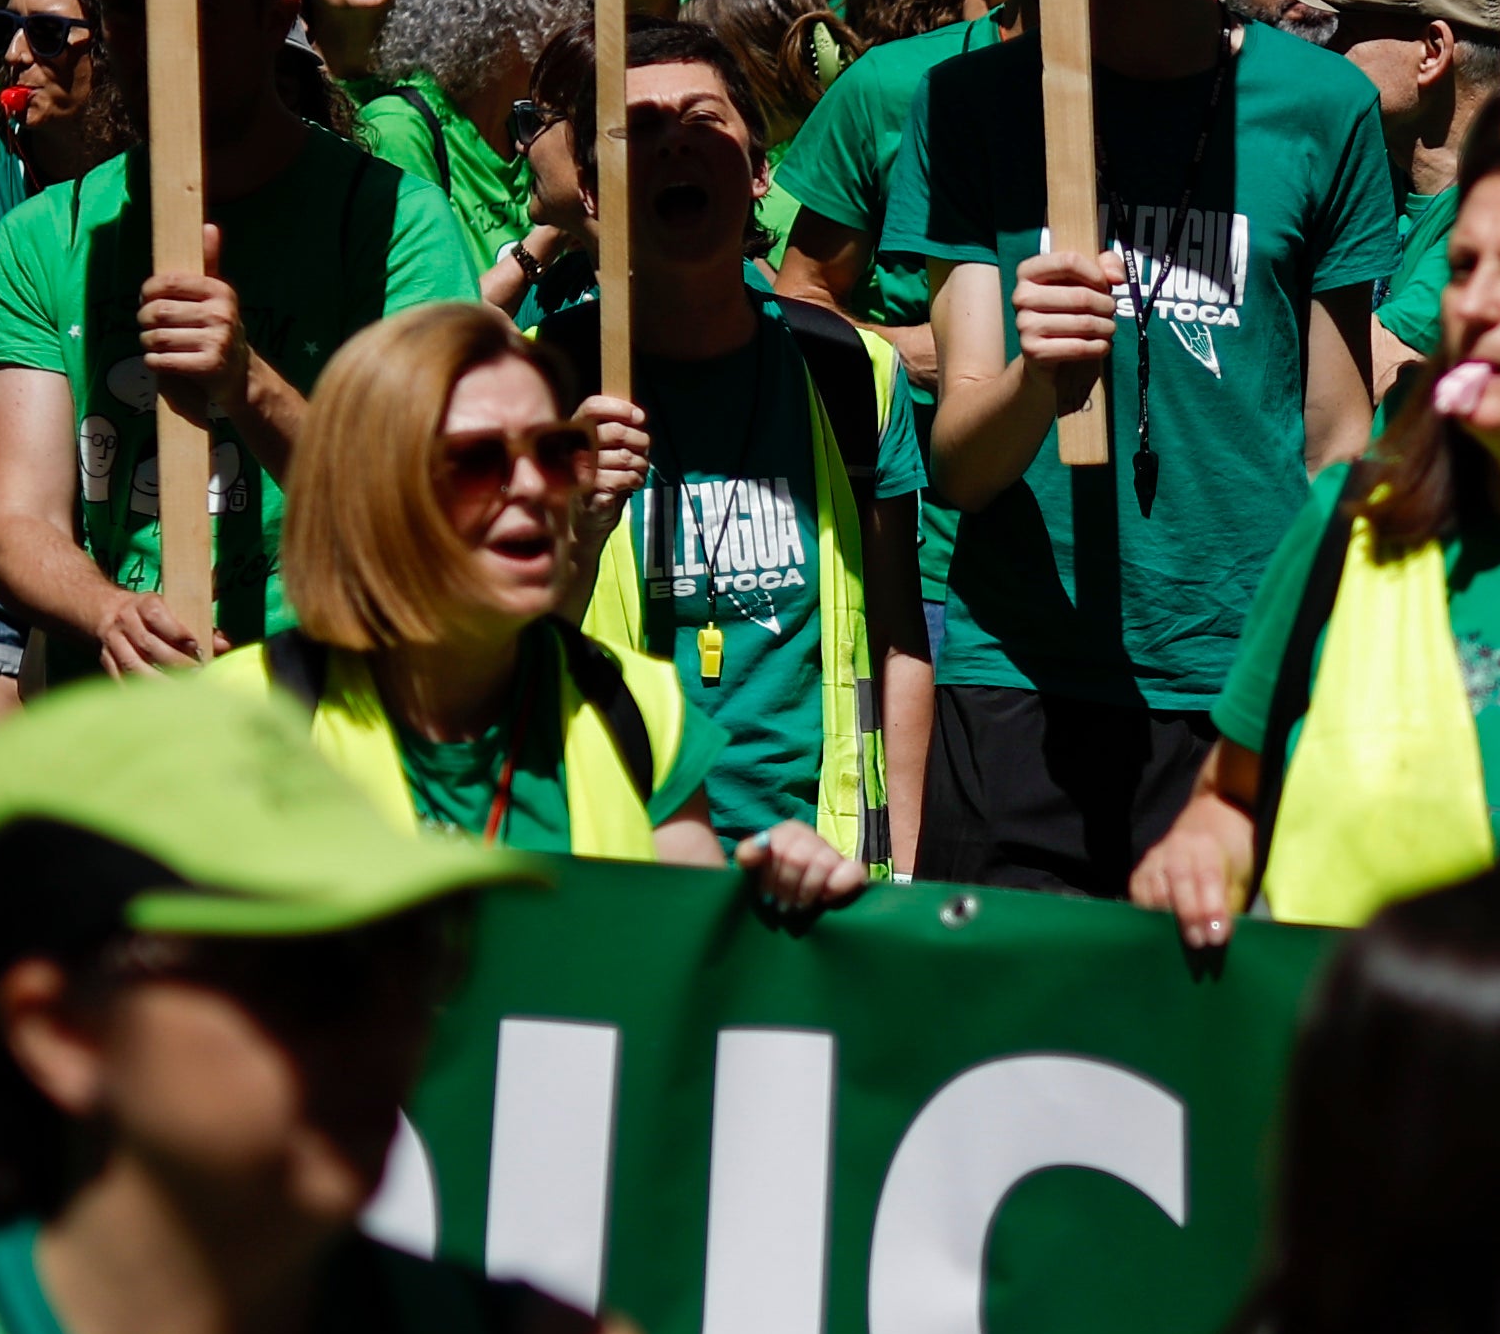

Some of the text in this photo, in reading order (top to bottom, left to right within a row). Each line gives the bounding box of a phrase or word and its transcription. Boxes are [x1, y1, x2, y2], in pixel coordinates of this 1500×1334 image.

[1153, 299, 1241, 328] TOCA
[643, 477, 805, 579] LLENGUA
[650, 568, 806, 599] ES TOCA
